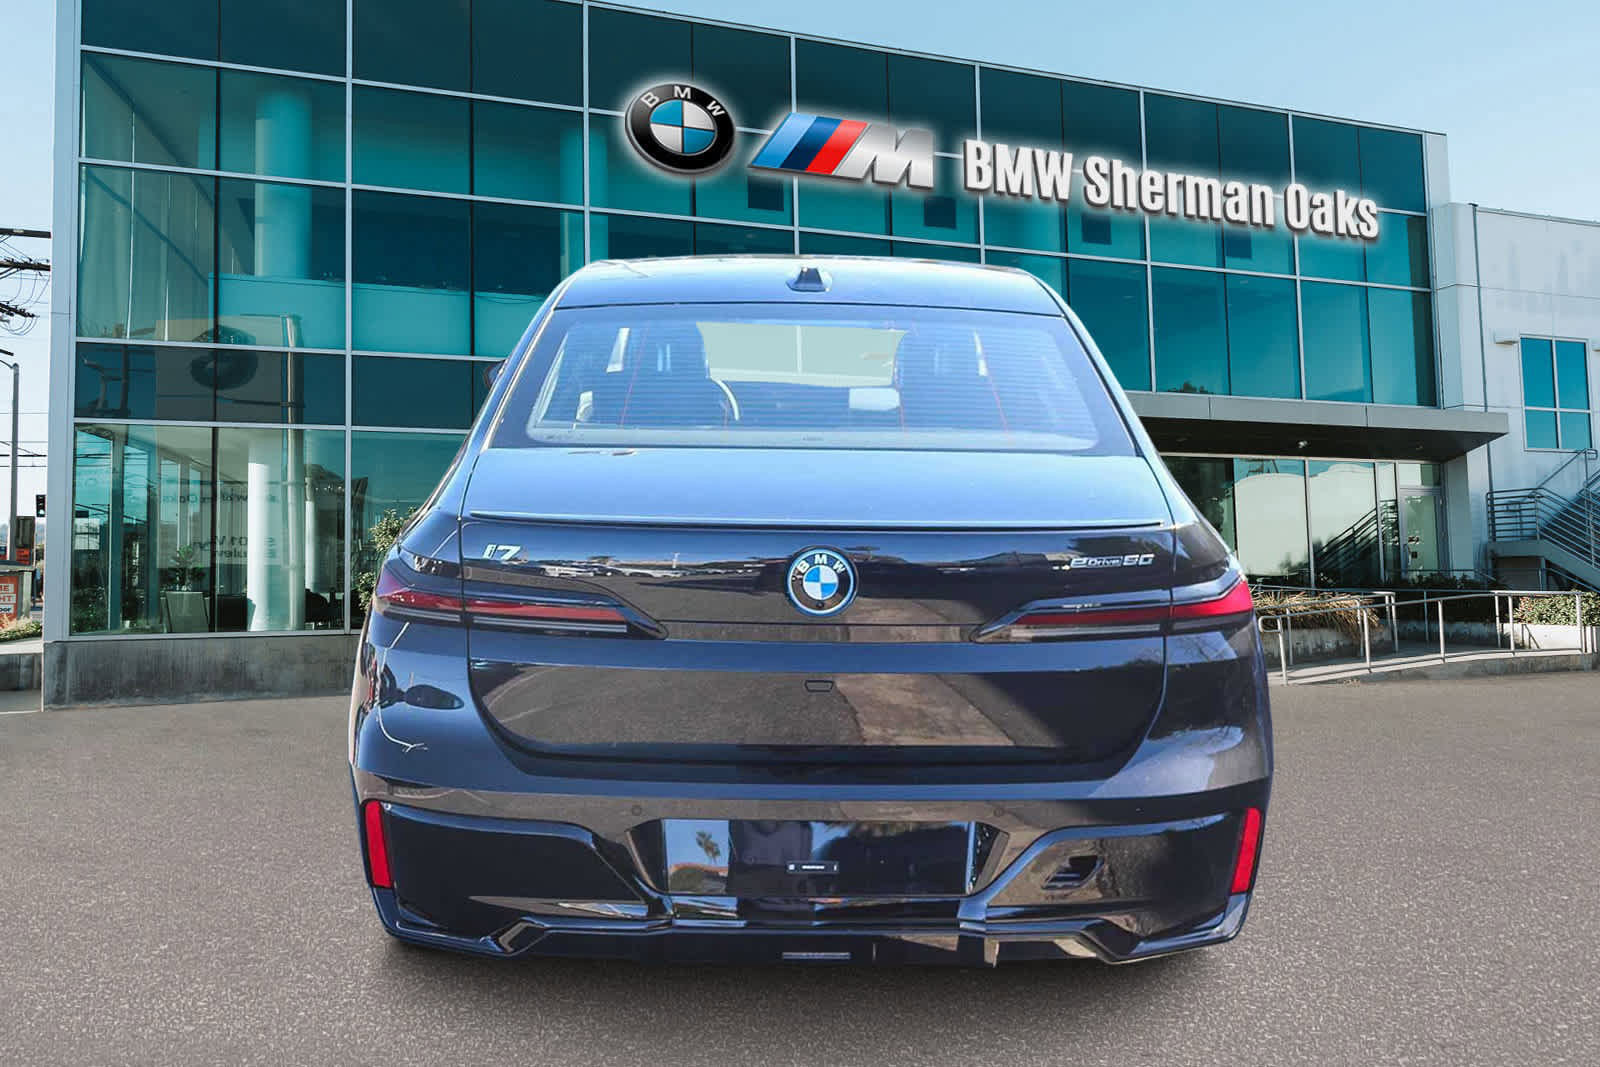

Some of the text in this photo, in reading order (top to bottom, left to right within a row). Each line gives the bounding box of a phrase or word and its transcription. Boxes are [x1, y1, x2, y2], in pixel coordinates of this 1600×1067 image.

[640, 85, 726, 117] BMW
[963, 138, 1379, 241] BMW Sherman Oaks
[796, 553, 846, 573] BMW
